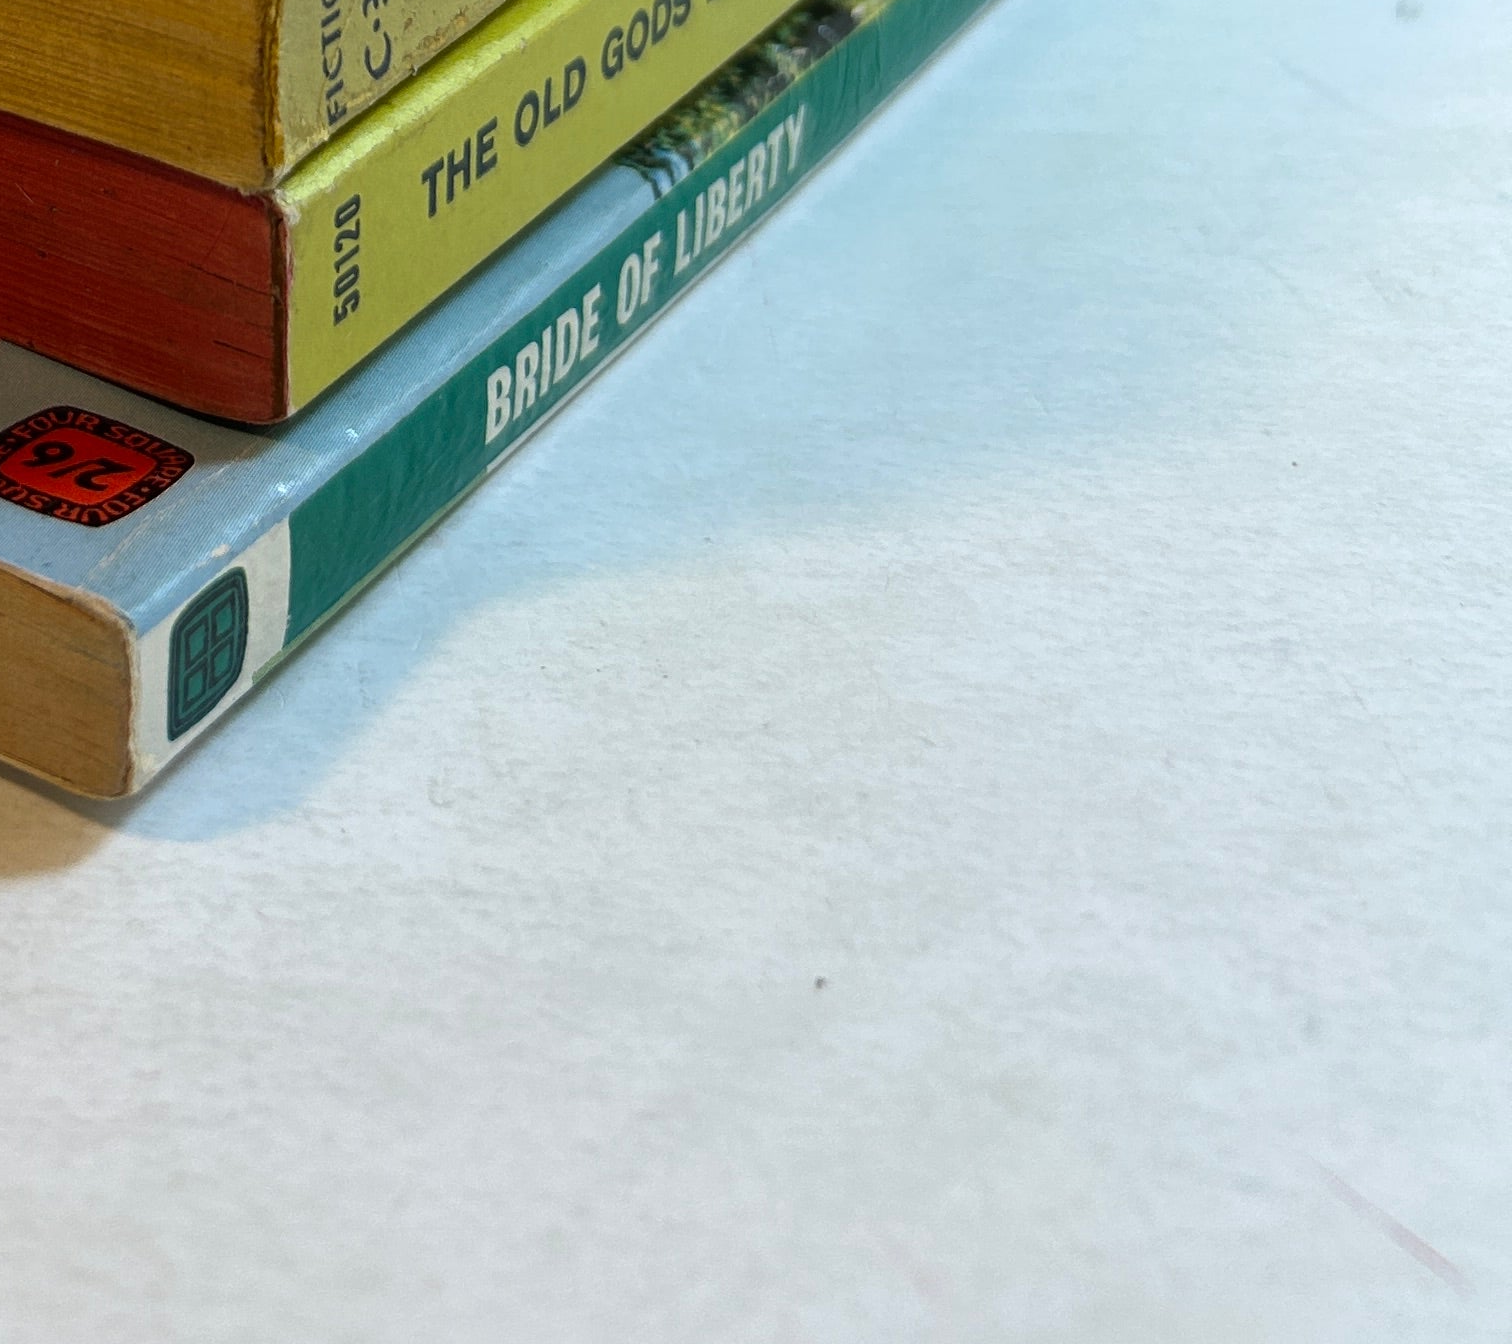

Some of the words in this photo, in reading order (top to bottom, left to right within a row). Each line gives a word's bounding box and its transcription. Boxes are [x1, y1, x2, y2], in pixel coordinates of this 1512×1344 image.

[421, 116, 498, 219] THE
[513, 55, 587, 148] OLD
[333, 192, 362, 327] 50120
[485, 282, 601, 448] BRIDE
[616, 230, 664, 328] OF
[672, 101, 808, 280] LIBERTY
[11, 410, 100, 440] FOUR
[104, 424, 187, 489] SQUARE
[20, 440, 139, 492] 2/6
[53, 487, 146, 523] FOUR
